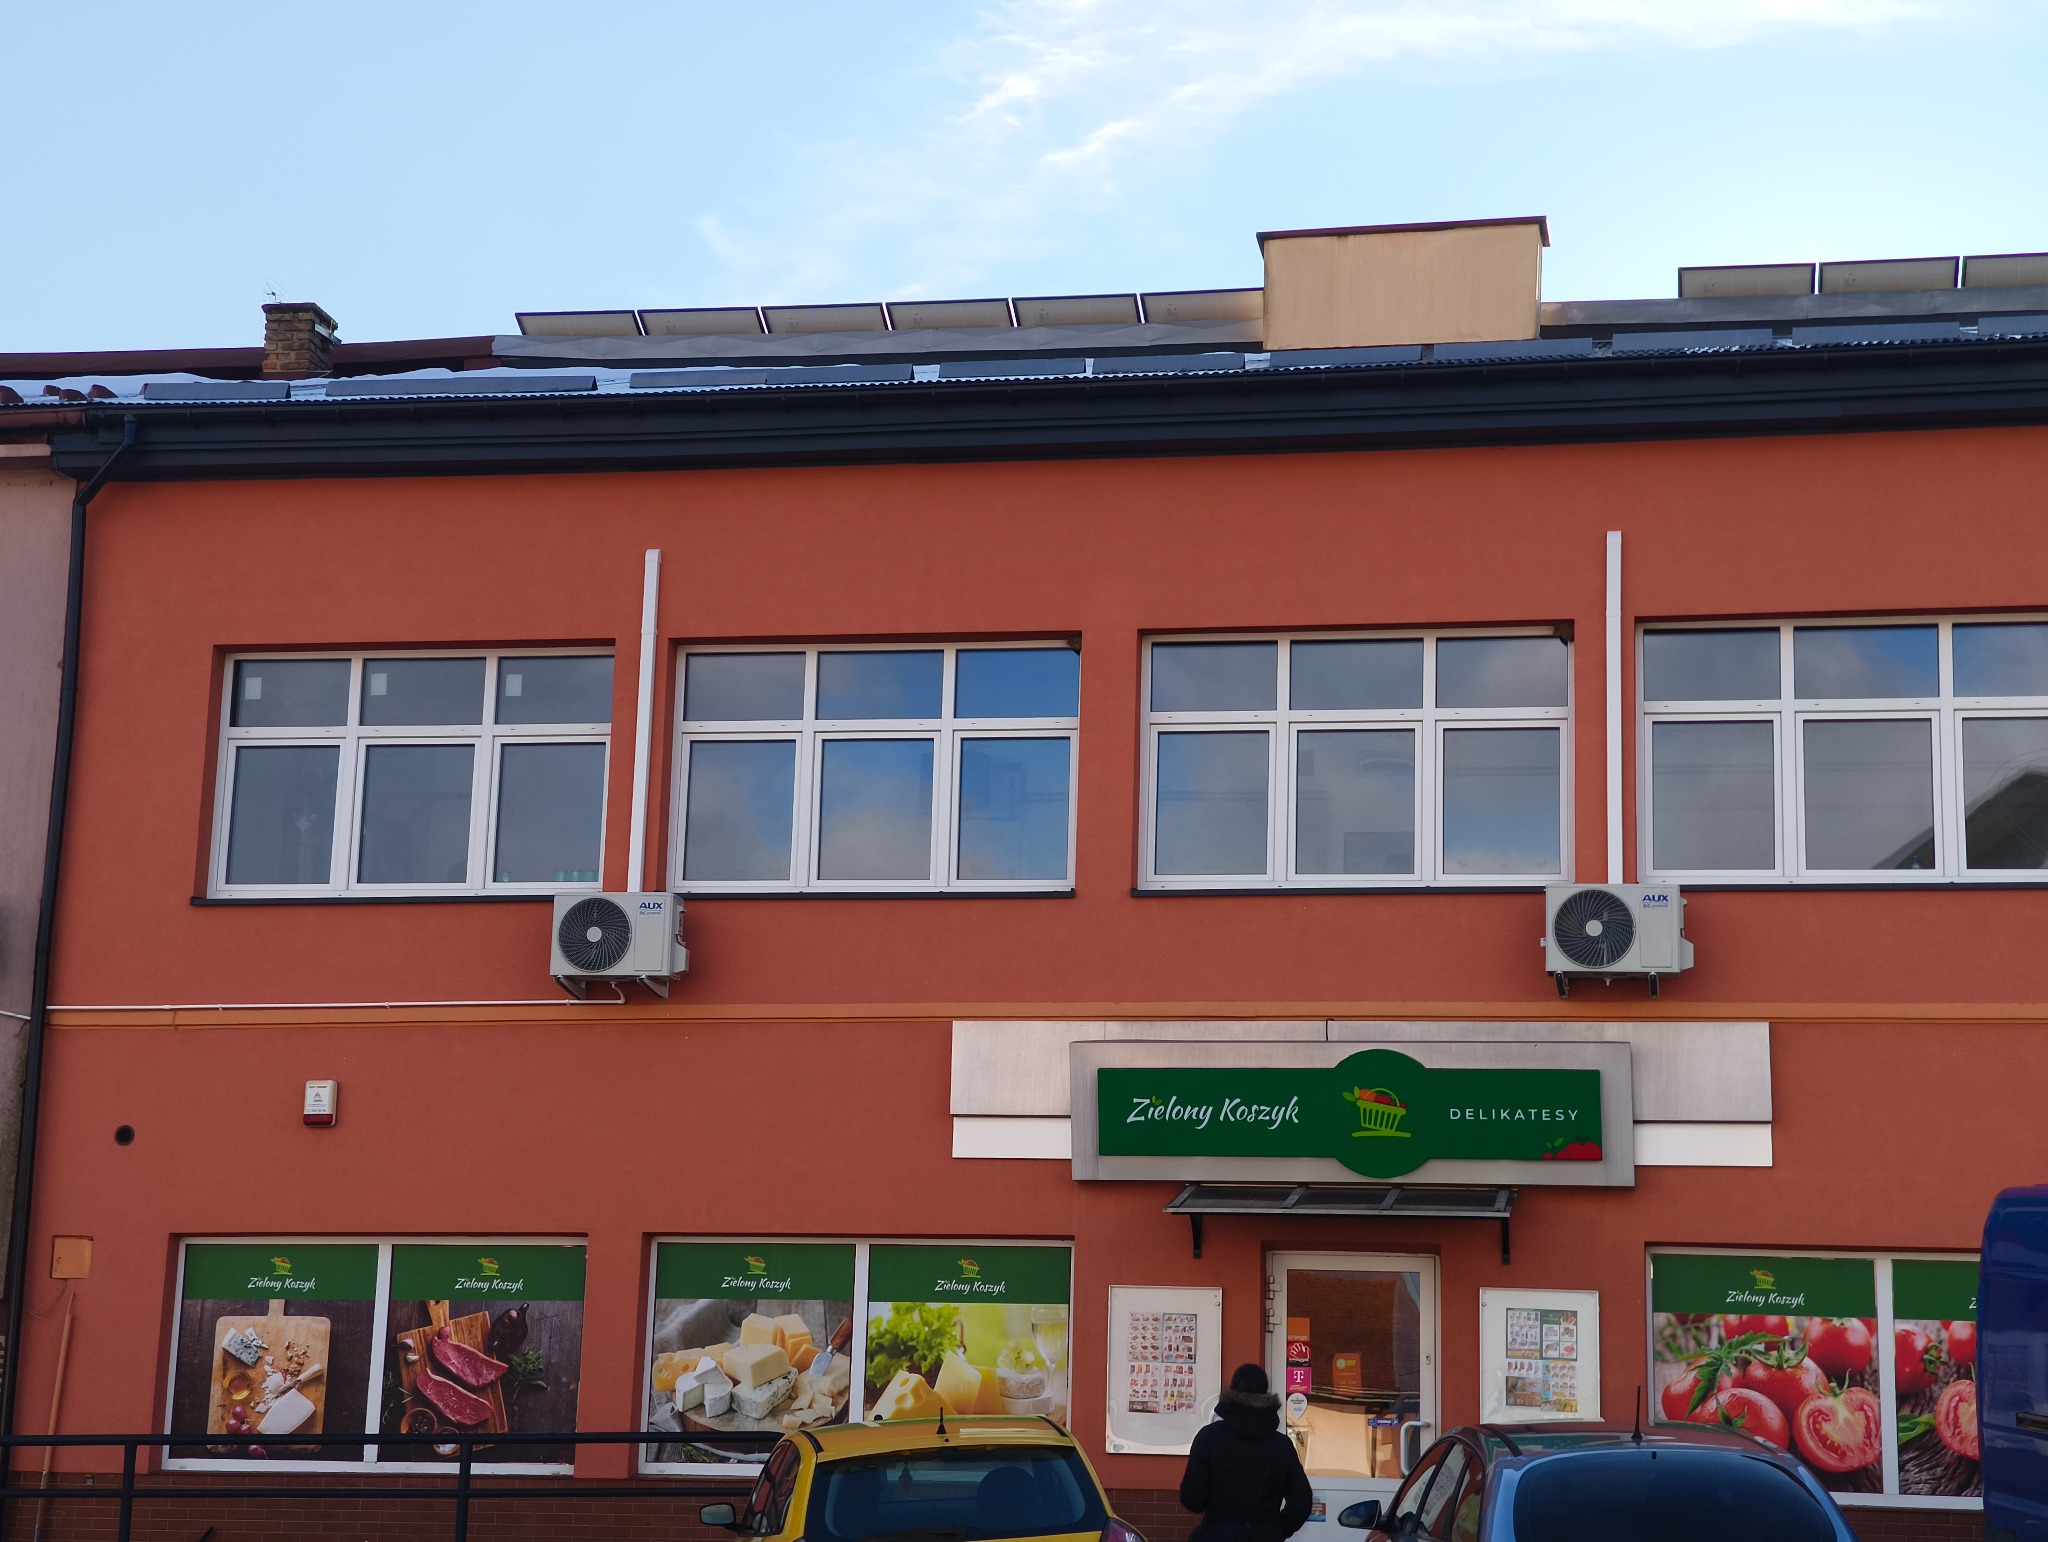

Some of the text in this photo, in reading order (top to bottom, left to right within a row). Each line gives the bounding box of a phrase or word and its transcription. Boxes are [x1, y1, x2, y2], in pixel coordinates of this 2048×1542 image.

[639, 902, 663, 910] AUX
[1642, 894, 1669, 902] AUX
[1126, 1095, 1299, 1130] Zielony Koszyk
[1449, 1108, 1578, 1121] DELIKATESY
[247, 1276, 316, 1293] Zielony Koszyk
[454, 1277, 524, 1294] Zielony Koszyk
[721, 1276, 791, 1293] Zielony Koszyk
[934, 1279, 1006, 1296] Zielony Koszyk
[1725, 1290, 1806, 1309] Zielony Koszyk
